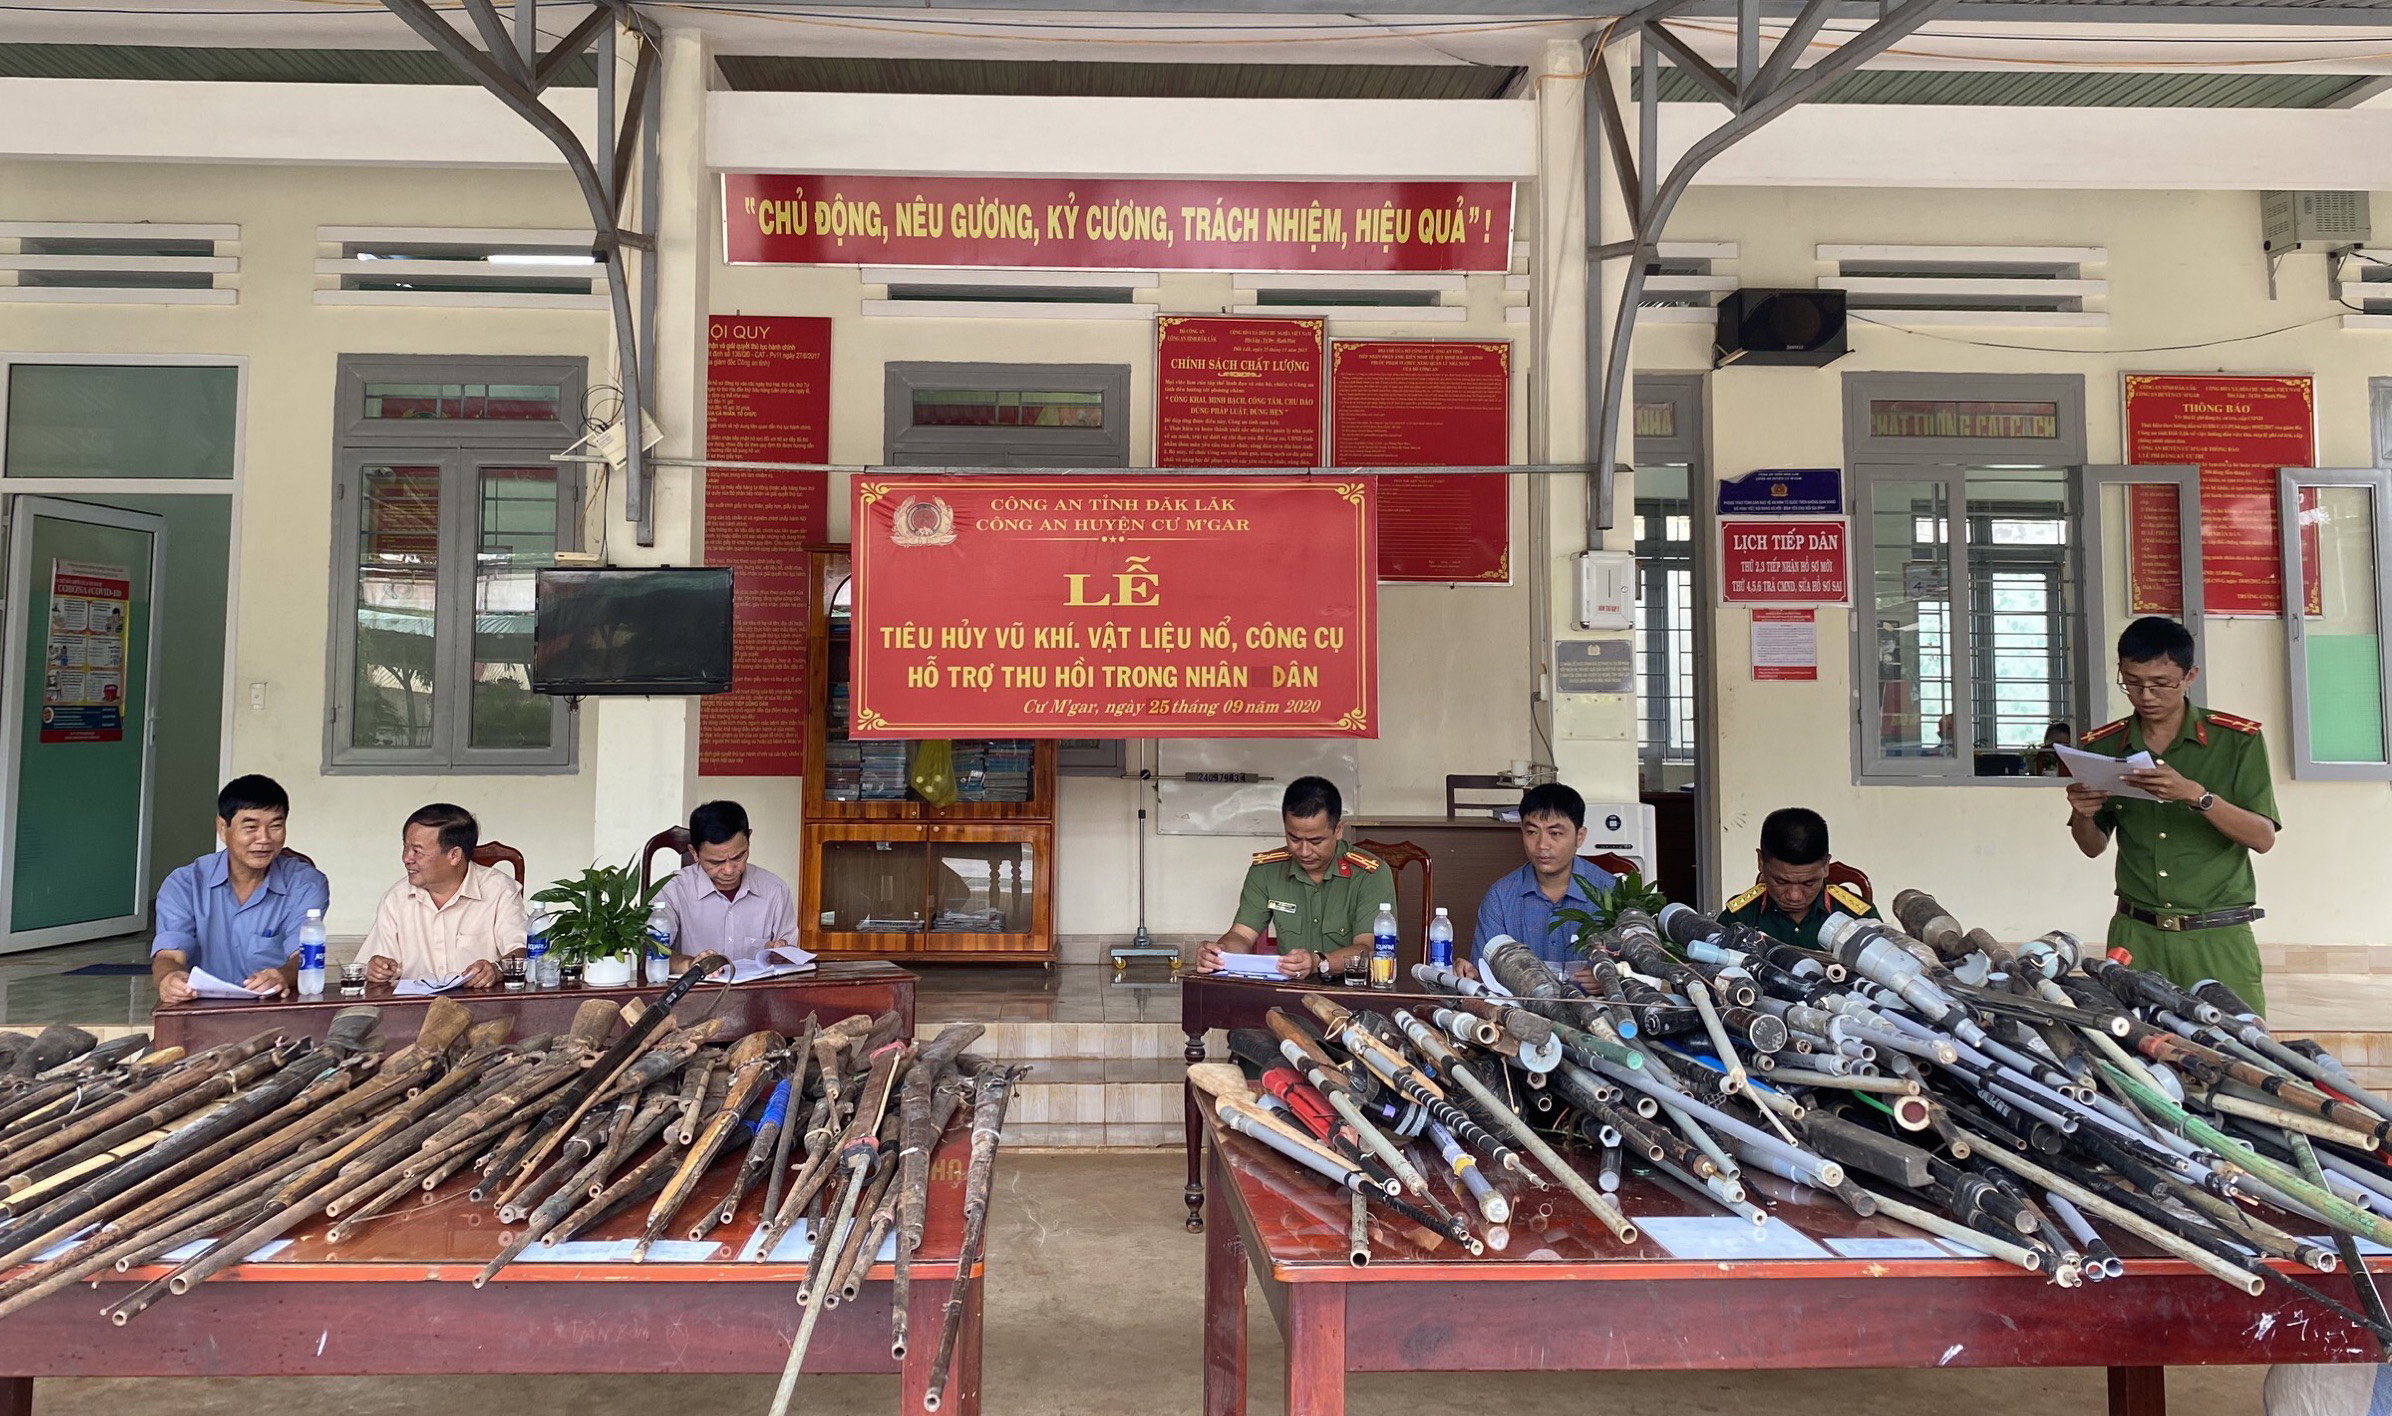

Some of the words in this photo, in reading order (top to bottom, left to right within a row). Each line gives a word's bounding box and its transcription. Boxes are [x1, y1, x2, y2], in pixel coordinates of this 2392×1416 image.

[815, 193, 888, 246] ĐỘNG,
[896, 195, 943, 238] NÊU
[951, 197, 1039, 246] GƯƠNG,
[1048, 192, 1079, 239] KỶ
[1087, 199, 1173, 248] CƯƠNG,
[1182, 198, 1258, 242] TRÁCH
[1266, 200, 1347, 252] NHIỆM,
[1355, 201, 1411, 253] HIỆU
[733, 325, 770, 339] QUY
[1171, 356, 1205, 369] CHÍNH
[1209, 357, 1237, 370] SÁCH
[1241, 357, 1269, 370] CHẤT
[1273, 359, 1309, 373] LƯỢNG
[2183, 402, 2222, 412] THÔNG
[2226, 403, 2250, 413] BÁO
[991, 496, 1047, 511] CÔNG
[1054, 499, 1082, 510] AN
[1089, 494, 1138, 510] TỈNH
[976, 516, 1032, 530] CÔNG
[1039, 519, 1067, 530] AN
[1074, 516, 1145, 534] HUYỆN
[1152, 517, 1180, 531] CƯ
[1734, 535, 1768, 553] LỊCH
[1772, 528, 1804, 550] TIẾP
[1809, 531, 1838, 550] DÂN
[1767, 557, 1781, 572] TIẾP
[1782, 560, 1799, 575] NHẬN
[1064, 556, 1159, 605] LỄ
[1732, 579, 1745, 592] THỨ
[1763, 578, 1776, 592] TRẢ
[1832, 581, 1842, 591] SAI
[880, 621, 932, 648] TIÊU
[942, 619, 987, 648] HỦY
[995, 622, 1024, 648] VŨ
[1088, 621, 1131, 653] VẬT
[1141, 621, 1191, 653] LIỆU
[1201, 616, 1237, 652] NỔ,
[1246, 622, 1306, 648] CÔNG
[1314, 627, 1343, 653] CỤ
[909, 656, 939, 688] HỖ
[947, 663, 994, 692] TRỢ
[1001, 667, 1046, 688] THU
[1056, 657, 1093, 688] HỒI
[1102, 666, 1177, 688] TRONG
[1186, 660, 1247, 687] NHÂN
[1273, 660, 1317, 687] DÂN
[1024, 699, 1048, 713] Cư
[1105, 700, 1145, 716] ngày
[1148, 700, 1170, 714] 25
[1172, 699, 1219, 716] tháng
[1223, 700, 1243, 713] 09
[1245, 701, 1279, 713] năm
[1284, 700, 1321, 713] 2020
